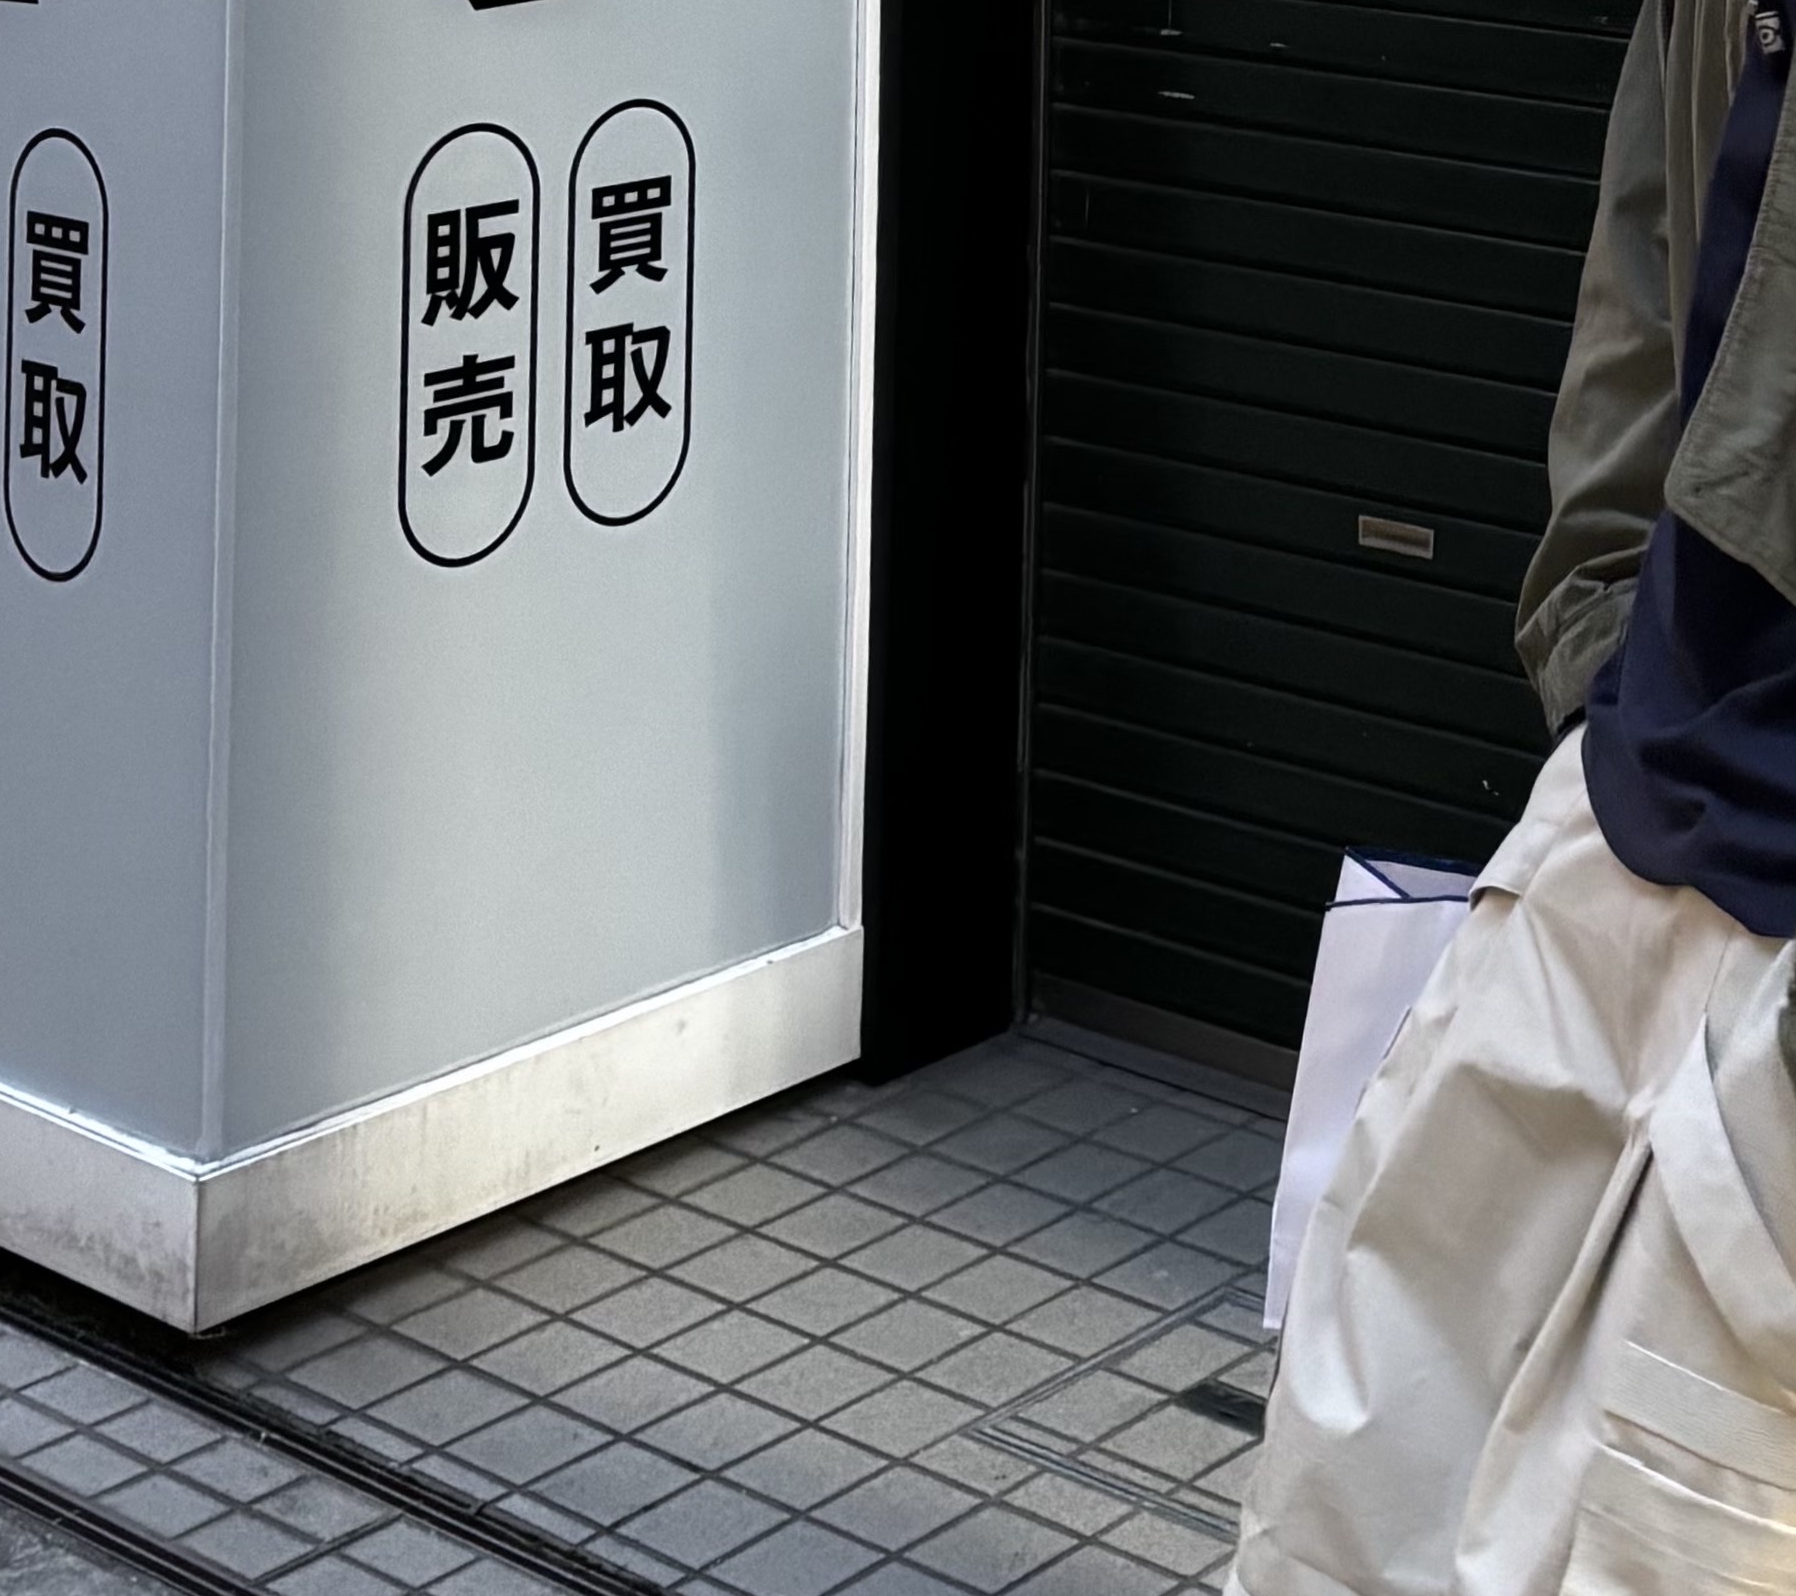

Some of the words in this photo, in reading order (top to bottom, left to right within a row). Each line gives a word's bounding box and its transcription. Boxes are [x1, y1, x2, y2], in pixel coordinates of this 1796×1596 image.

[19, 210, 90, 485] 買取
[420, 198, 520, 477] 販売
[584, 175, 672, 433] 買取
